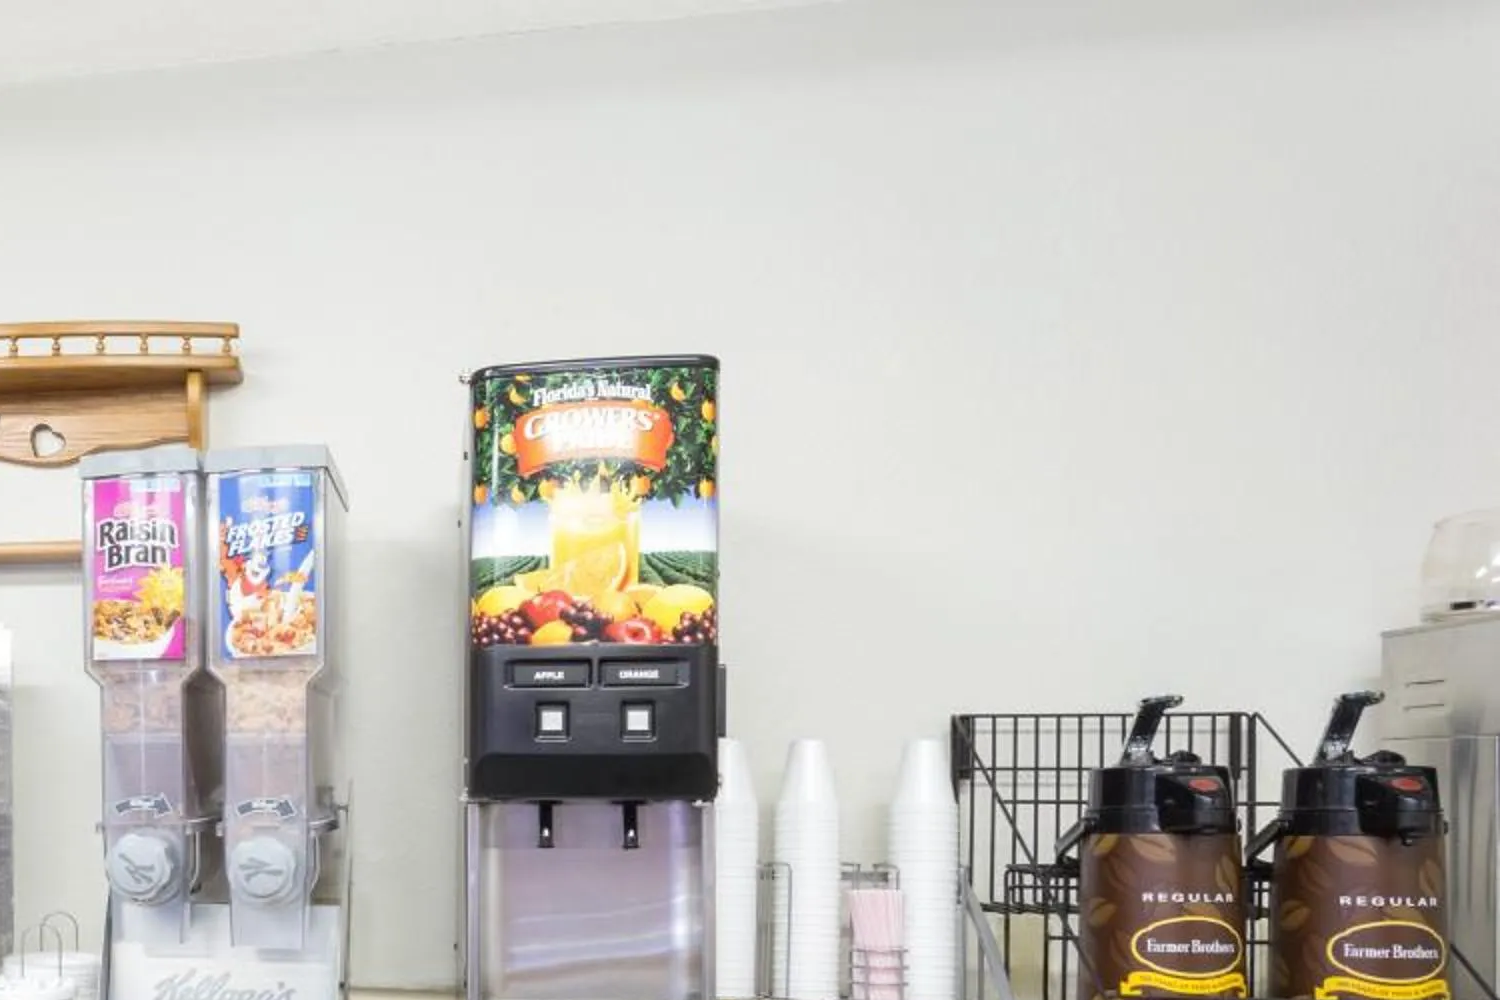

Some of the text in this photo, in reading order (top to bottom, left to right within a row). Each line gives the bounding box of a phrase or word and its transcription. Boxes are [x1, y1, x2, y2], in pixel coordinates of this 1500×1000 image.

[598, 380, 651, 400] Natural
[99, 520, 175, 548] Raisin
[226, 512, 305, 544] FROSTED
[228, 530, 295, 557] FLAKES
[107, 544, 167, 569] Bran
[534, 671, 565, 680] APPLE
[619, 669, 659, 679] ORANGE
[1142, 892, 1234, 903] REGULAR
[1339, 895, 1438, 907] REGULAR
[1147, 938, 1234, 953] Farmer Brothers
[1343, 943, 1439, 959] Farmer Brothers
